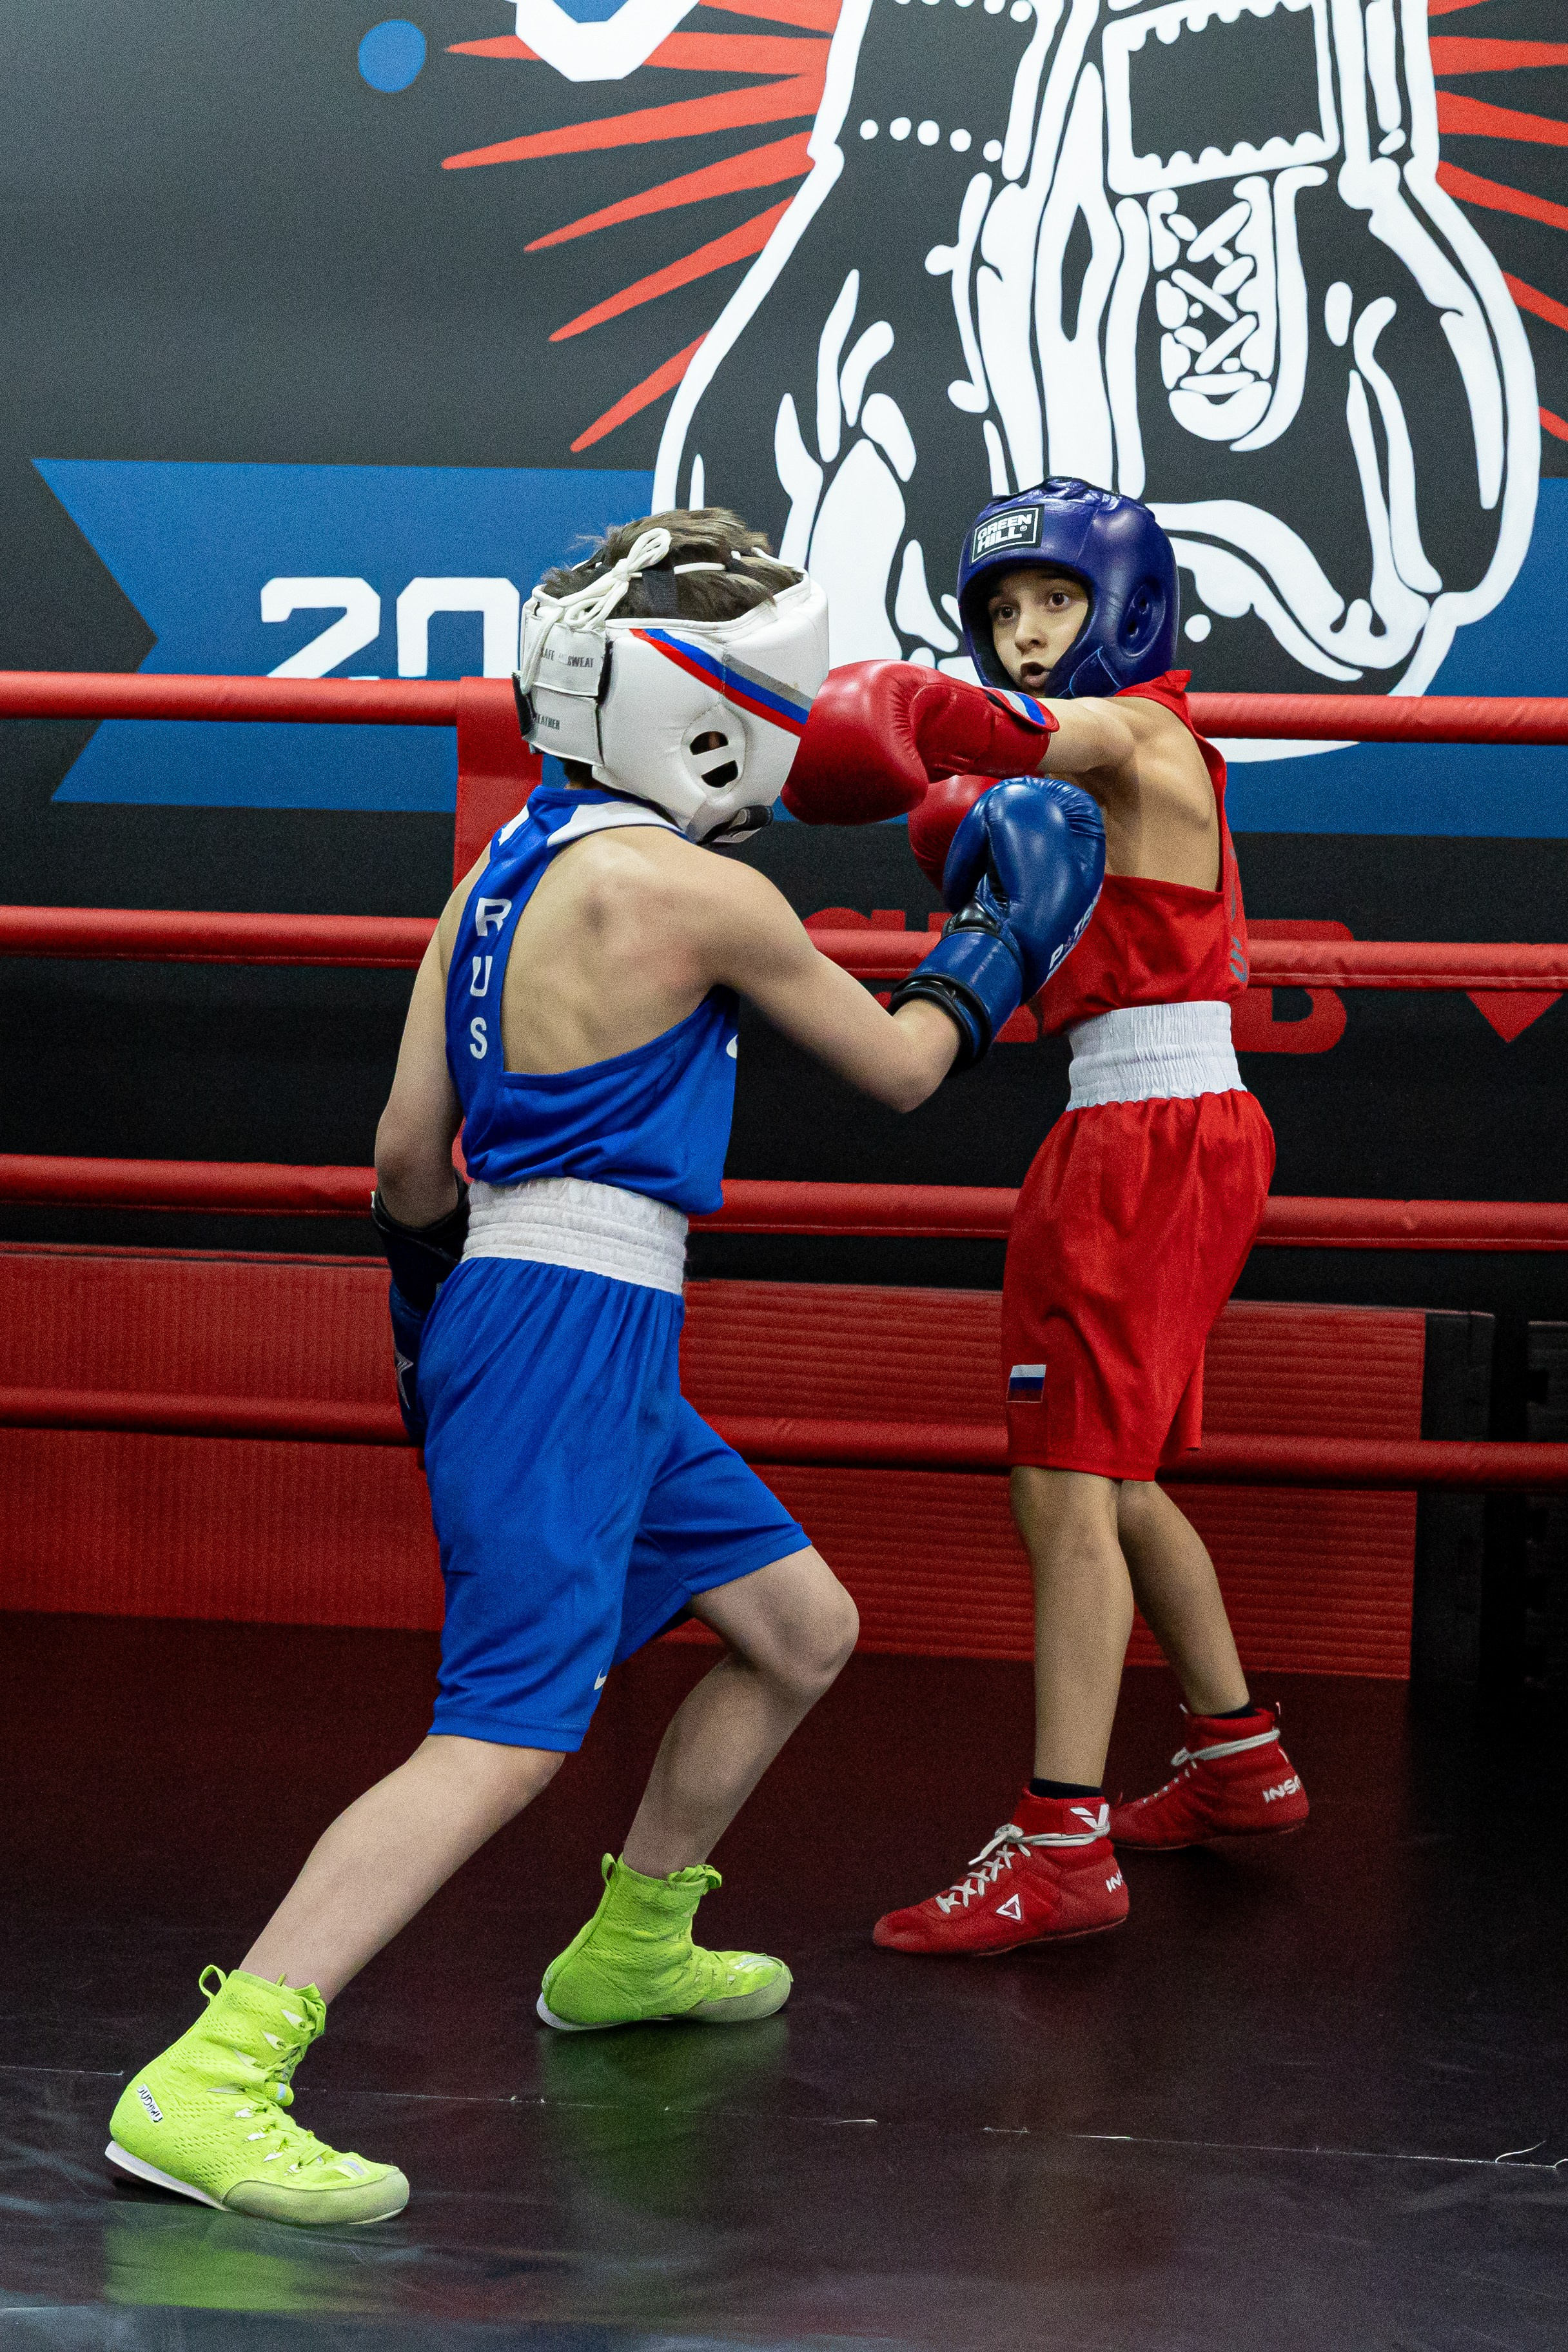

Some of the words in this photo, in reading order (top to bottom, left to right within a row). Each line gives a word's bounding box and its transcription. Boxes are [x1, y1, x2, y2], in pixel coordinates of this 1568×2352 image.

[977, 513, 1032, 541] GREEN
[977, 526, 1023, 554] HILL
[469, 897, 512, 1059] RUS
